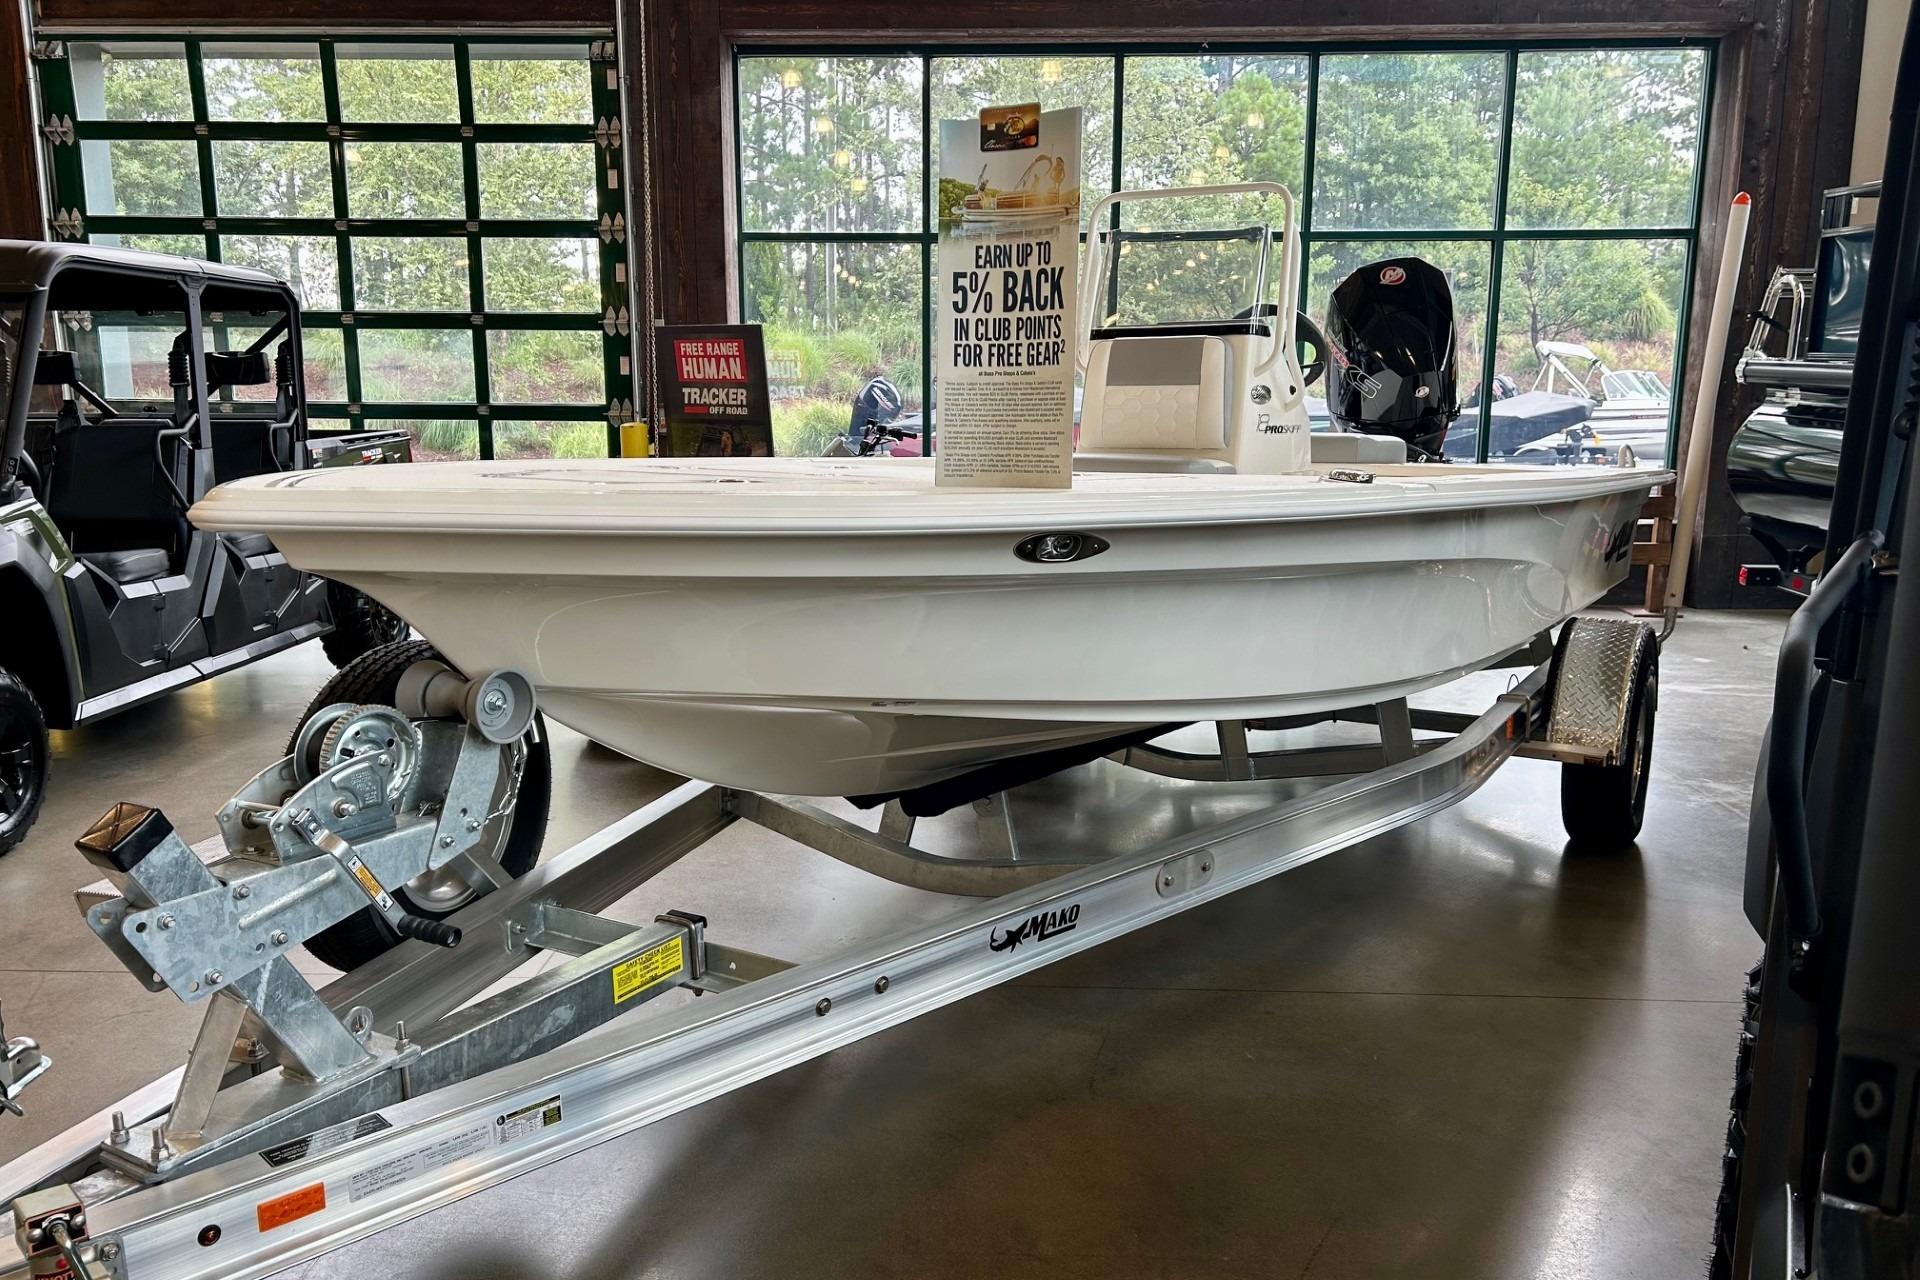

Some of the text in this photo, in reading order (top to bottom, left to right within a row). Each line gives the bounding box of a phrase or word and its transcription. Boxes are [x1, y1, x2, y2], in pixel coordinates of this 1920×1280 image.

[975, 241, 1051, 269] EARN UP TO
[952, 267, 1065, 314] 5% BACK
[954, 314, 1062, 342] IN CLUB POINTS
[680, 342, 740, 356] FREE RANGE
[953, 343, 983, 367] FOR
[988, 343, 1023, 367] FREE
[682, 357, 745, 380] HUMAN.
[682, 387, 748, 405] TRACKER
[709, 406, 748, 415] OFF ROAD
[1022, 904, 1081, 942] MAKO
